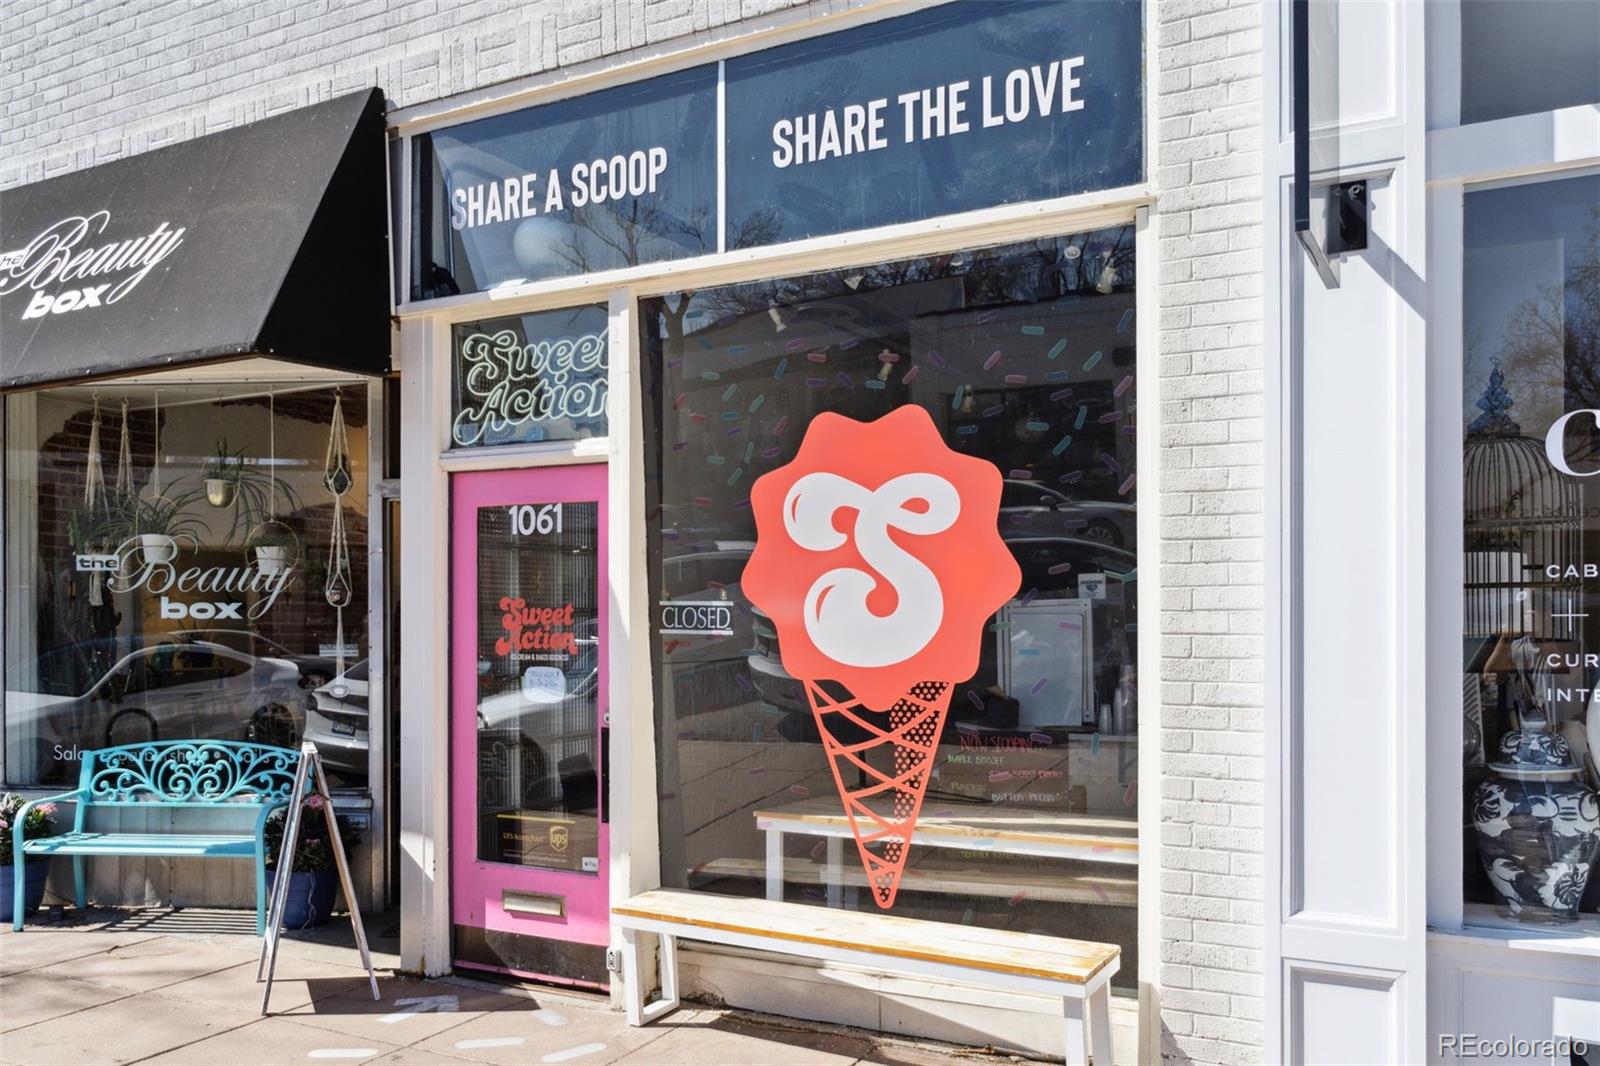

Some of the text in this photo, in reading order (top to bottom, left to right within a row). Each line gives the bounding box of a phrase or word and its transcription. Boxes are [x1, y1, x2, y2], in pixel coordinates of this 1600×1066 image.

[772, 56, 1085, 169] SHARE THE LOVE
[451, 147, 668, 231] SHARE A SCOOP
[0, 210, 186, 305] Beauty
[22, 284, 112, 320] box
[508, 502, 563, 536] 1061
[107, 534, 296, 620] Beauty
[1546, 563, 1599, 578] CAB
[160, 596, 244, 620] box
[499, 596, 574, 631] Sweet
[662, 606, 731, 629] CLOSED
[495, 624, 579, 656] Action
[551, 833, 567, 848] ups
